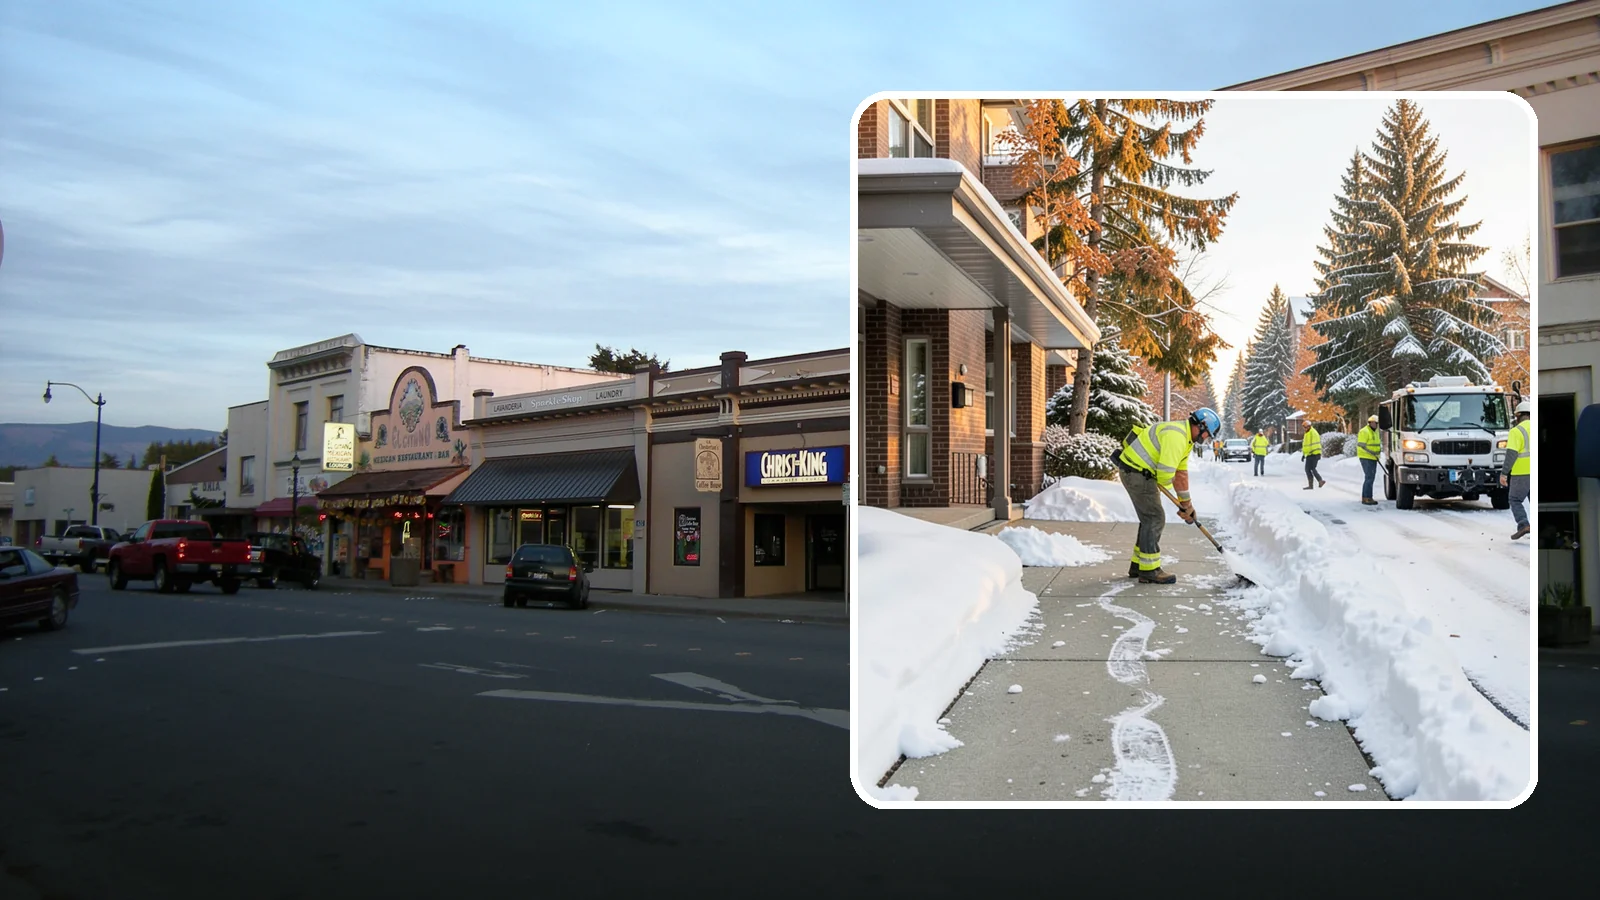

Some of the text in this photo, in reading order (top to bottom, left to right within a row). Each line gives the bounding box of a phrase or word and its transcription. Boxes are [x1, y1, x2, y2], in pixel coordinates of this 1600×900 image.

[596, 389, 624, 400] LAUNDRY
[493, 402, 523, 412] LAVANDERIA
[530, 394, 582, 409] Sparkle Shop
[397, 452, 433, 462] RESTAURANT
[438, 450, 450, 459] BAR
[760, 450, 827, 478] CHRIST KING
